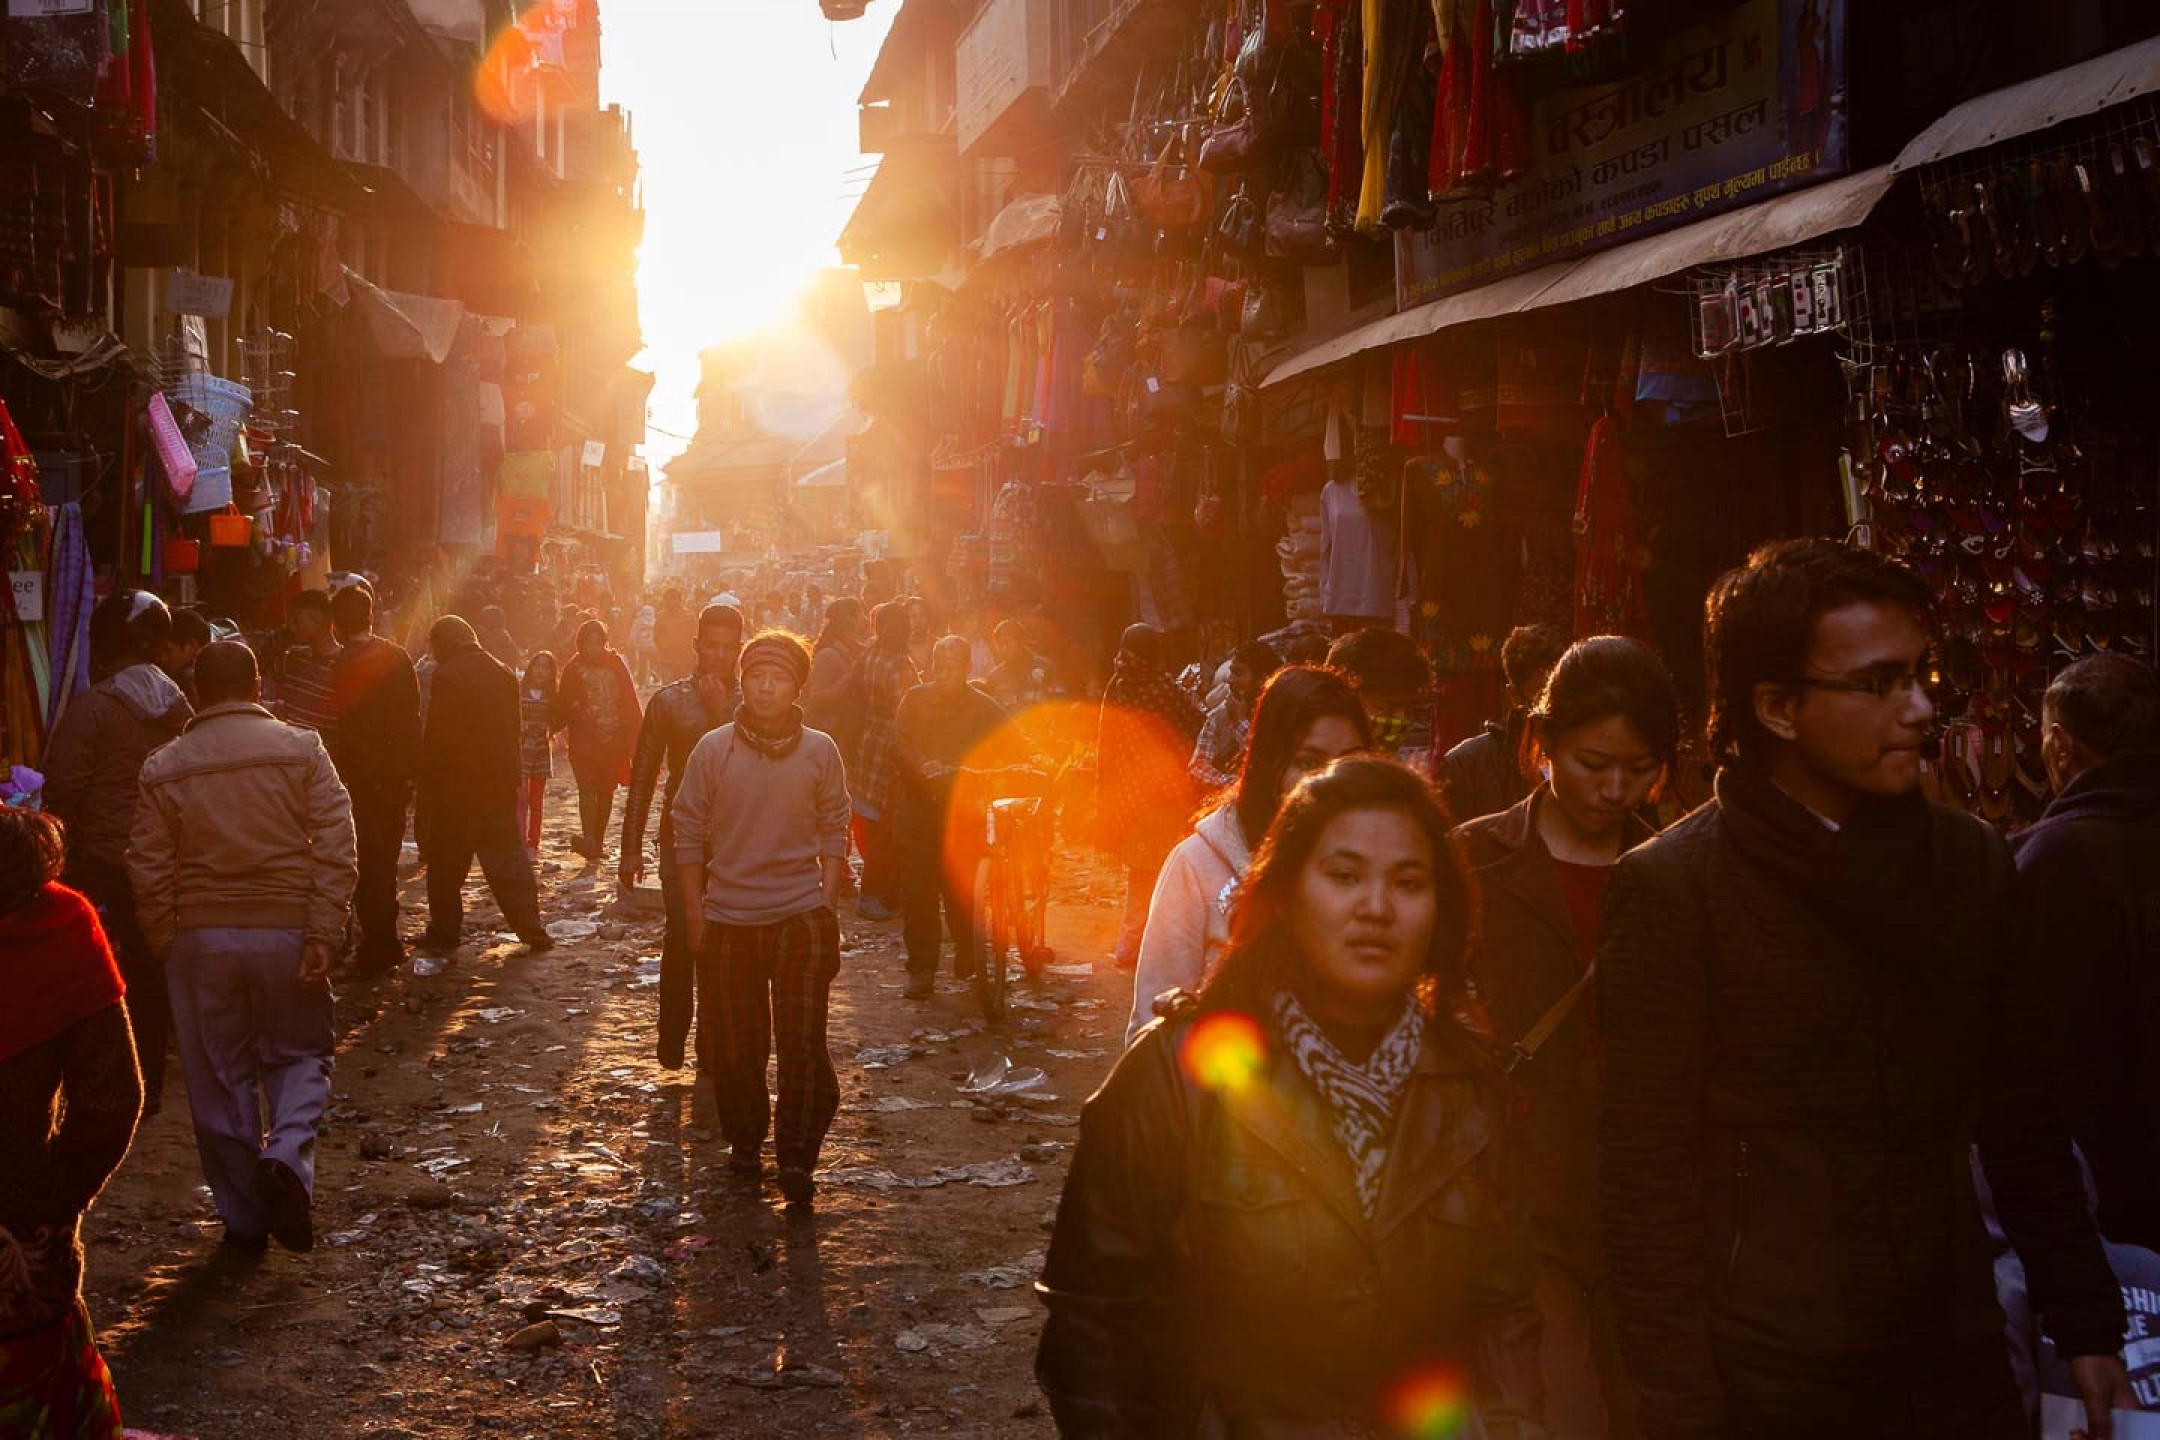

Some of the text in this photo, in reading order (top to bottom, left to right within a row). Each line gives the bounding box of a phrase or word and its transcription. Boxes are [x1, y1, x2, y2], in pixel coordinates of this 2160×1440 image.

[1547, 38, 1731, 154] वस्त्रालय
[1591, 134, 1670, 185] कपडा
[1682, 98, 1768, 150] पसल
